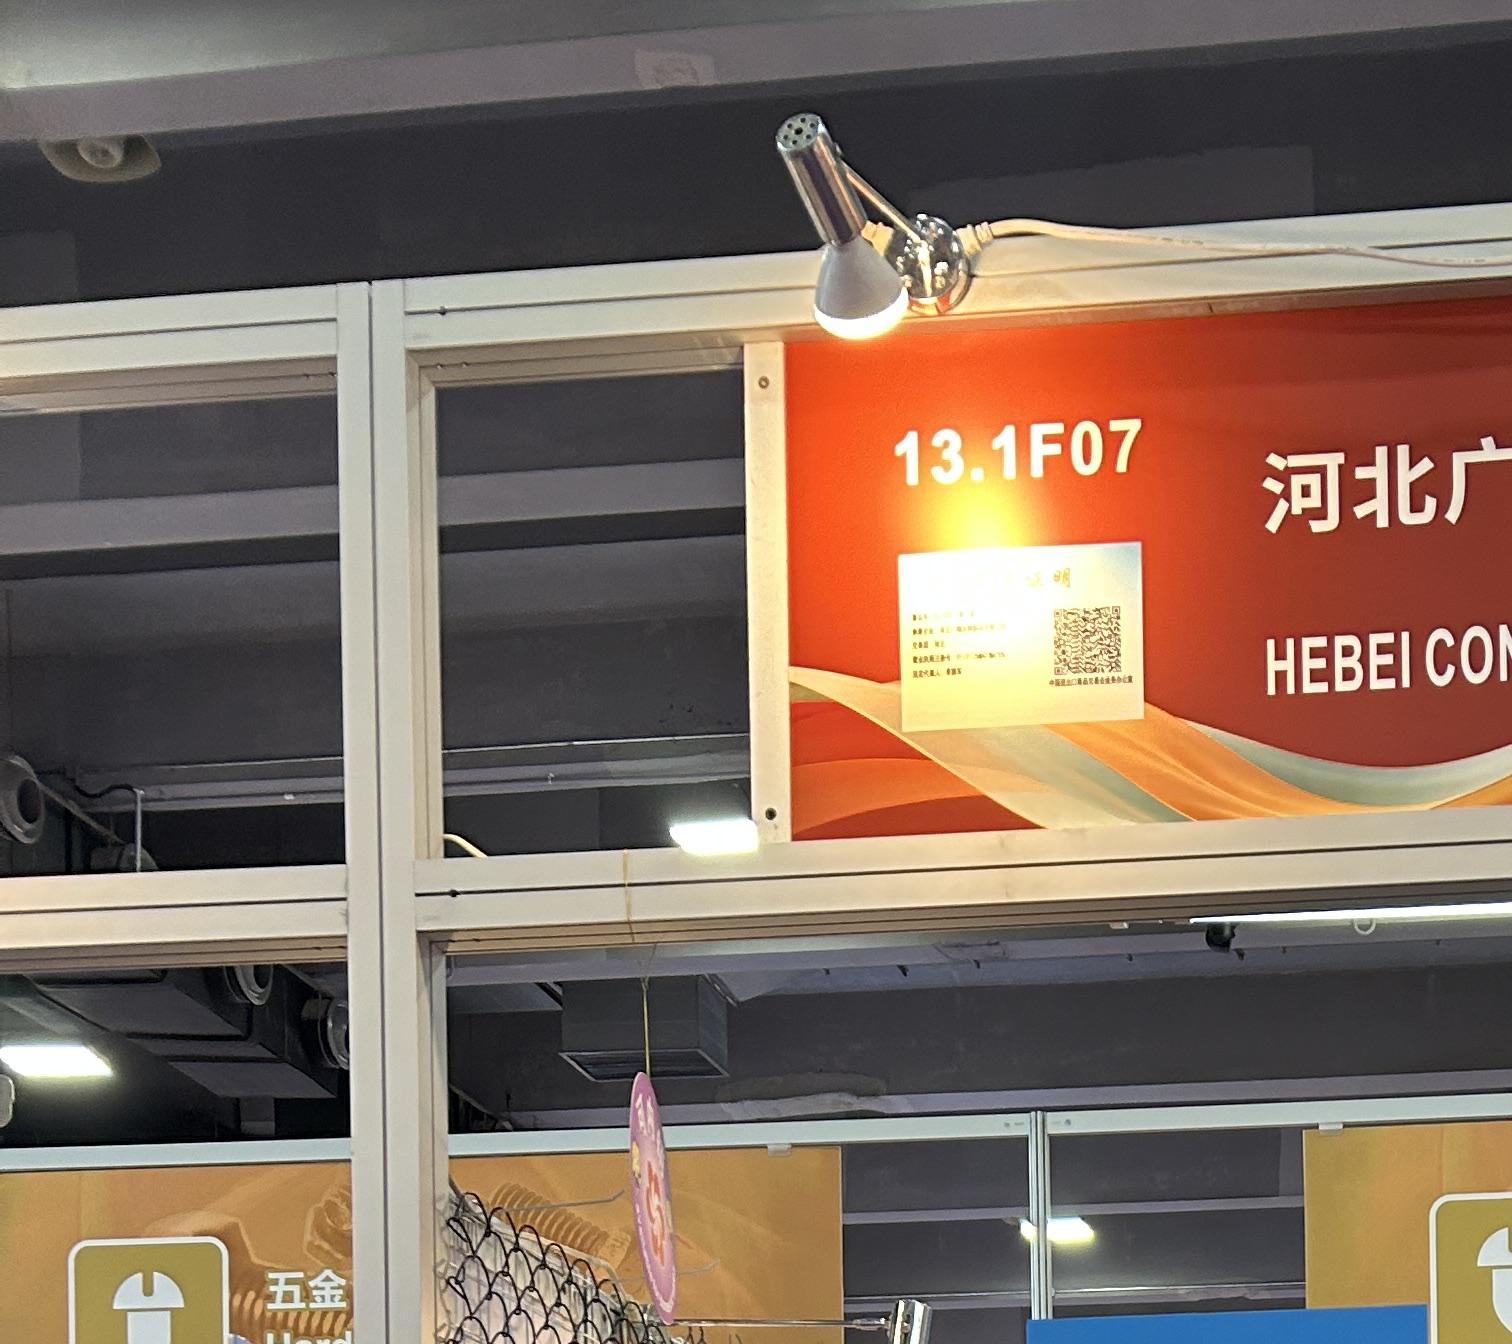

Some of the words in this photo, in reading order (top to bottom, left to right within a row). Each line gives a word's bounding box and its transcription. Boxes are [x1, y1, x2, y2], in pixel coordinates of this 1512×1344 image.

[894, 418, 1141, 486] 13.1F07
[1266, 630, 1410, 695] HEBEI
[266, 1270, 349, 1312] 五金
